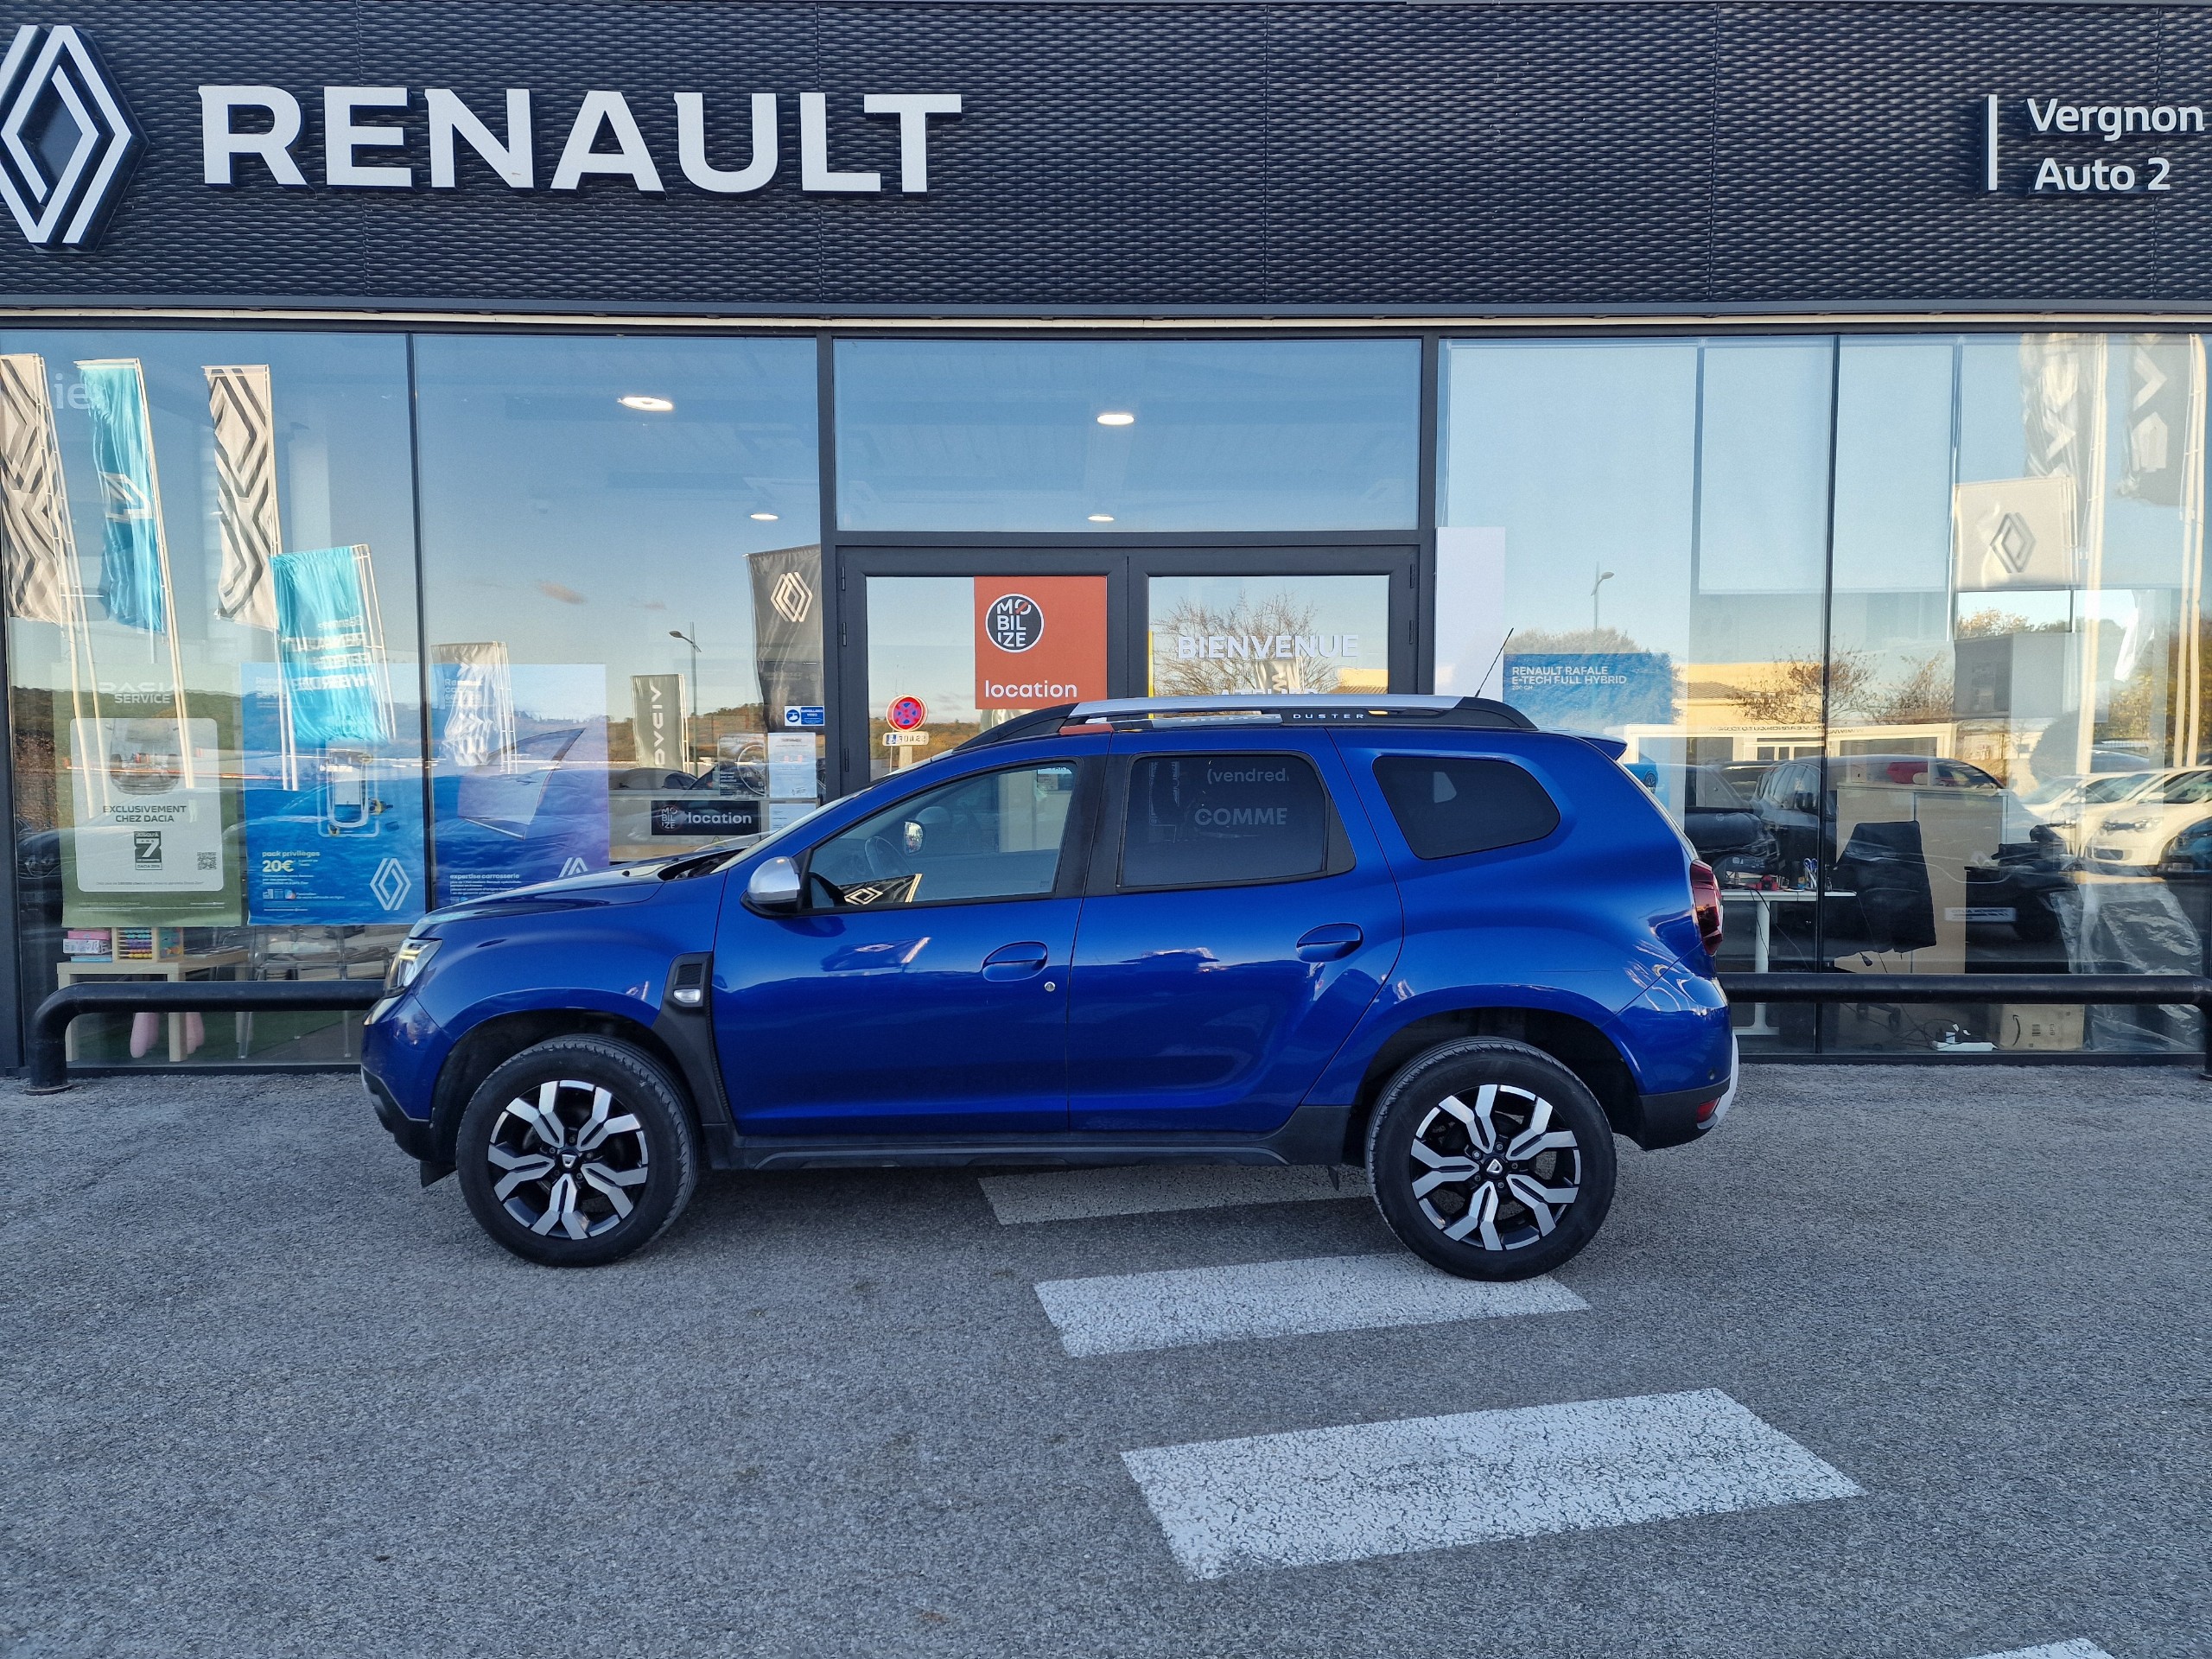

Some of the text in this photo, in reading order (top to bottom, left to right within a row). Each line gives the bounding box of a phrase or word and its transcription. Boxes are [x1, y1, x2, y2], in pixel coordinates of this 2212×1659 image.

[2026, 99, 2205, 142] Vergnon
[198, 86, 963, 194] RENAULT
[2034, 157, 2171, 191] Auto 2
[996, 614, 1027, 631] BIL
[997, 632, 1027, 647] IZE
[1178, 634, 1359, 659] BIENVENUE
[1512, 666, 1609, 676] RENAULT RAFALE
[1512, 675, 1627, 684] E-TECH FULL HYBRID
[985, 679, 1077, 697] location
[114, 693, 171, 704] SERVICE
[688, 812, 752, 824] location
